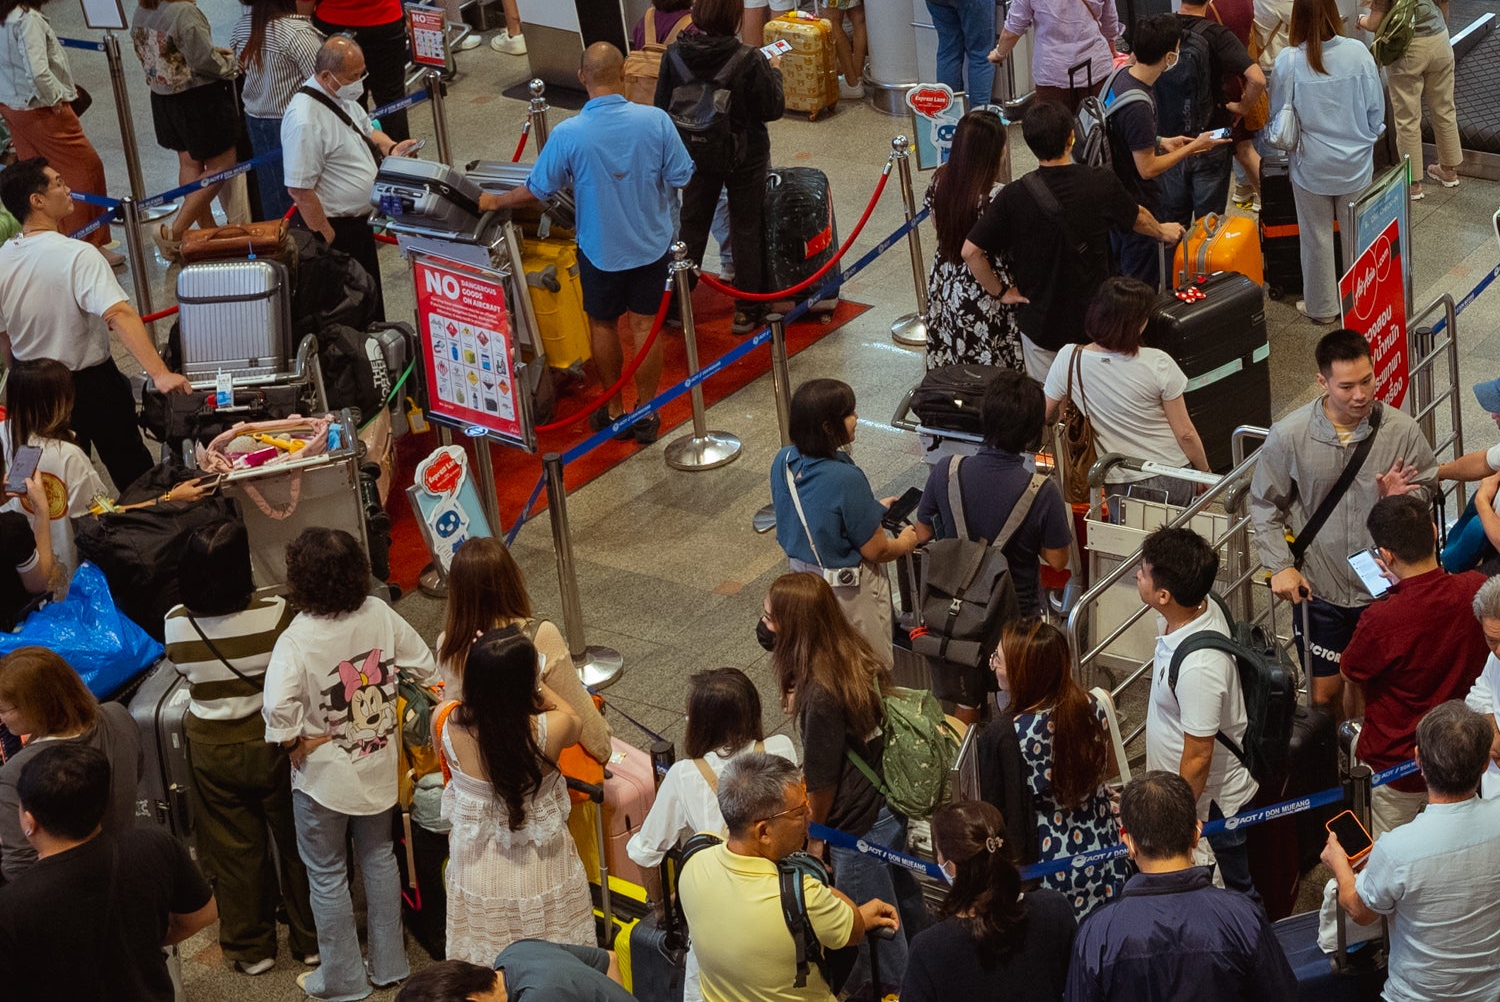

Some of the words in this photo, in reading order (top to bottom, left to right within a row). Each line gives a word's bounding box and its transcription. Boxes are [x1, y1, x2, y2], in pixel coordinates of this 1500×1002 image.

[424, 269, 460, 300] NO
[460, 279, 497, 296] DANGEROUS
[461, 288, 483, 300] GOODS
[462, 297, 473, 305] ON
[472, 299, 501, 313] AIRCRAFT
[1238, 812, 1258, 824] AOT
[1265, 807, 1281, 819] DON
[1280, 799, 1310, 813] MUEANG
[868, 846, 882, 858] AOT
[888, 853, 900, 863] DON
[901, 858, 927, 872] MUEANG
